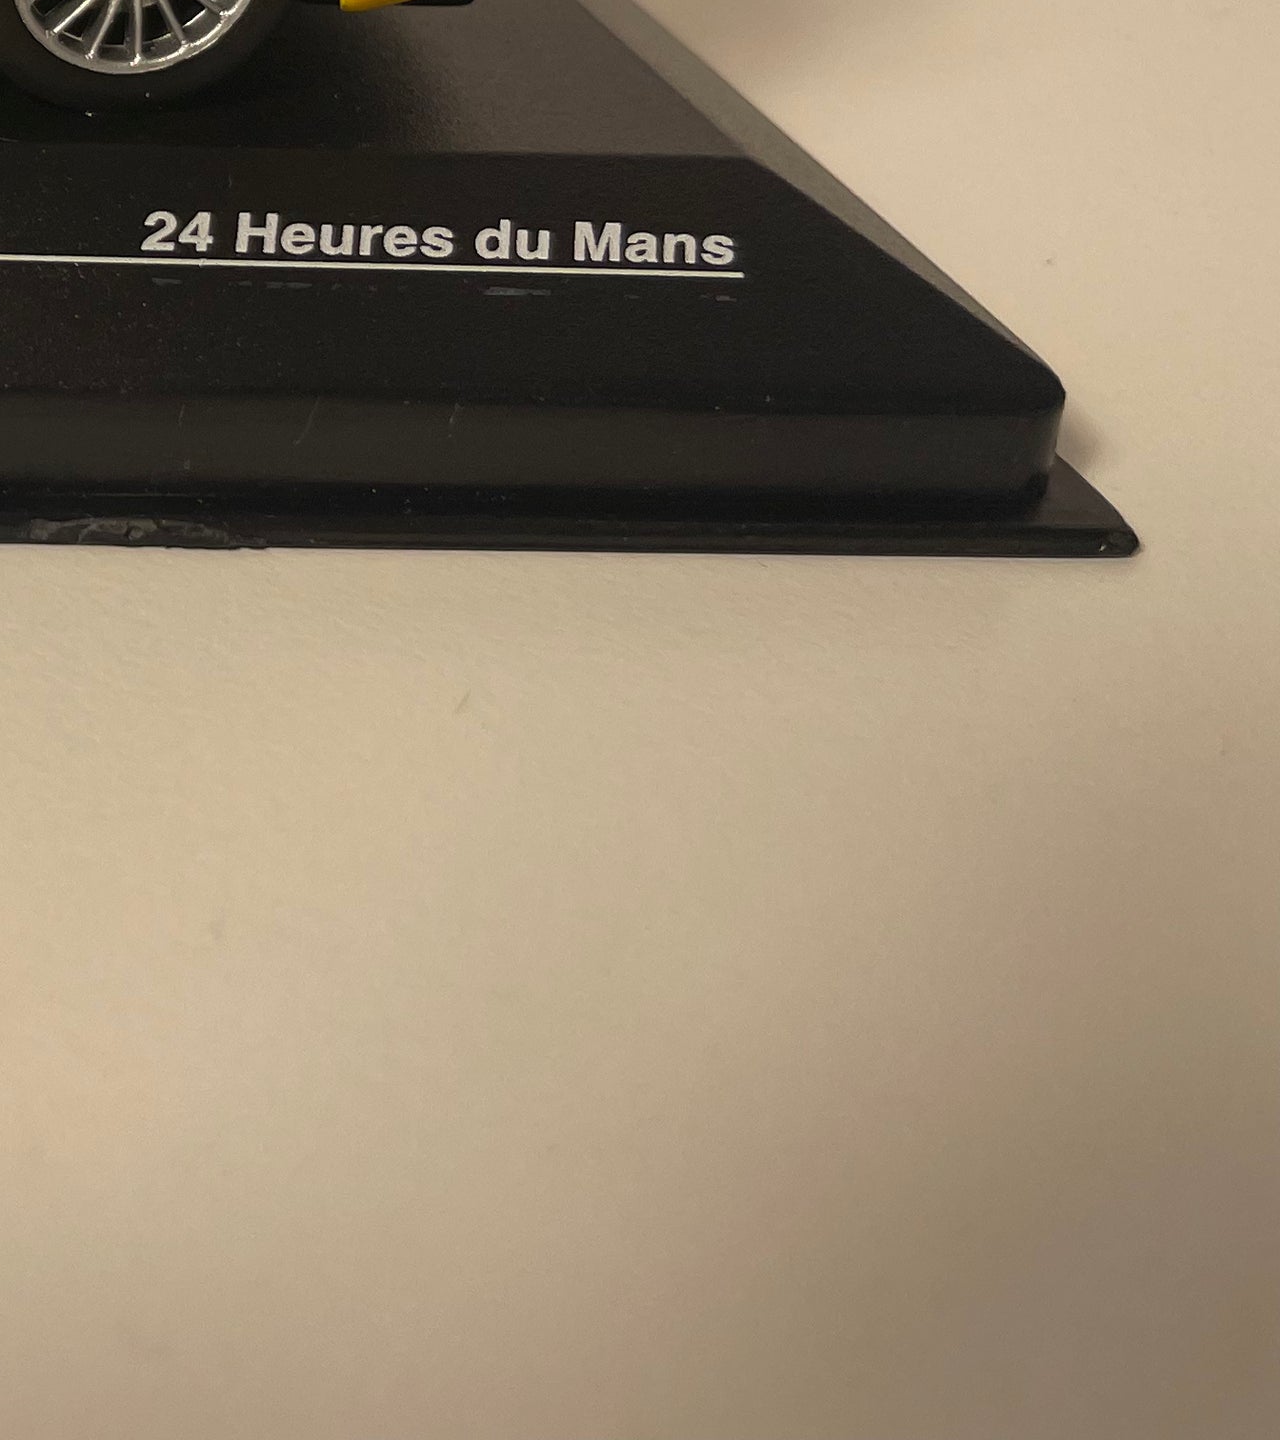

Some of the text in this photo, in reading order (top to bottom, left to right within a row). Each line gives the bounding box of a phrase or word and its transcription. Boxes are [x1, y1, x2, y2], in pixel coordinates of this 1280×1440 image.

[140, 210, 735, 266] 24 Heures du Mans
